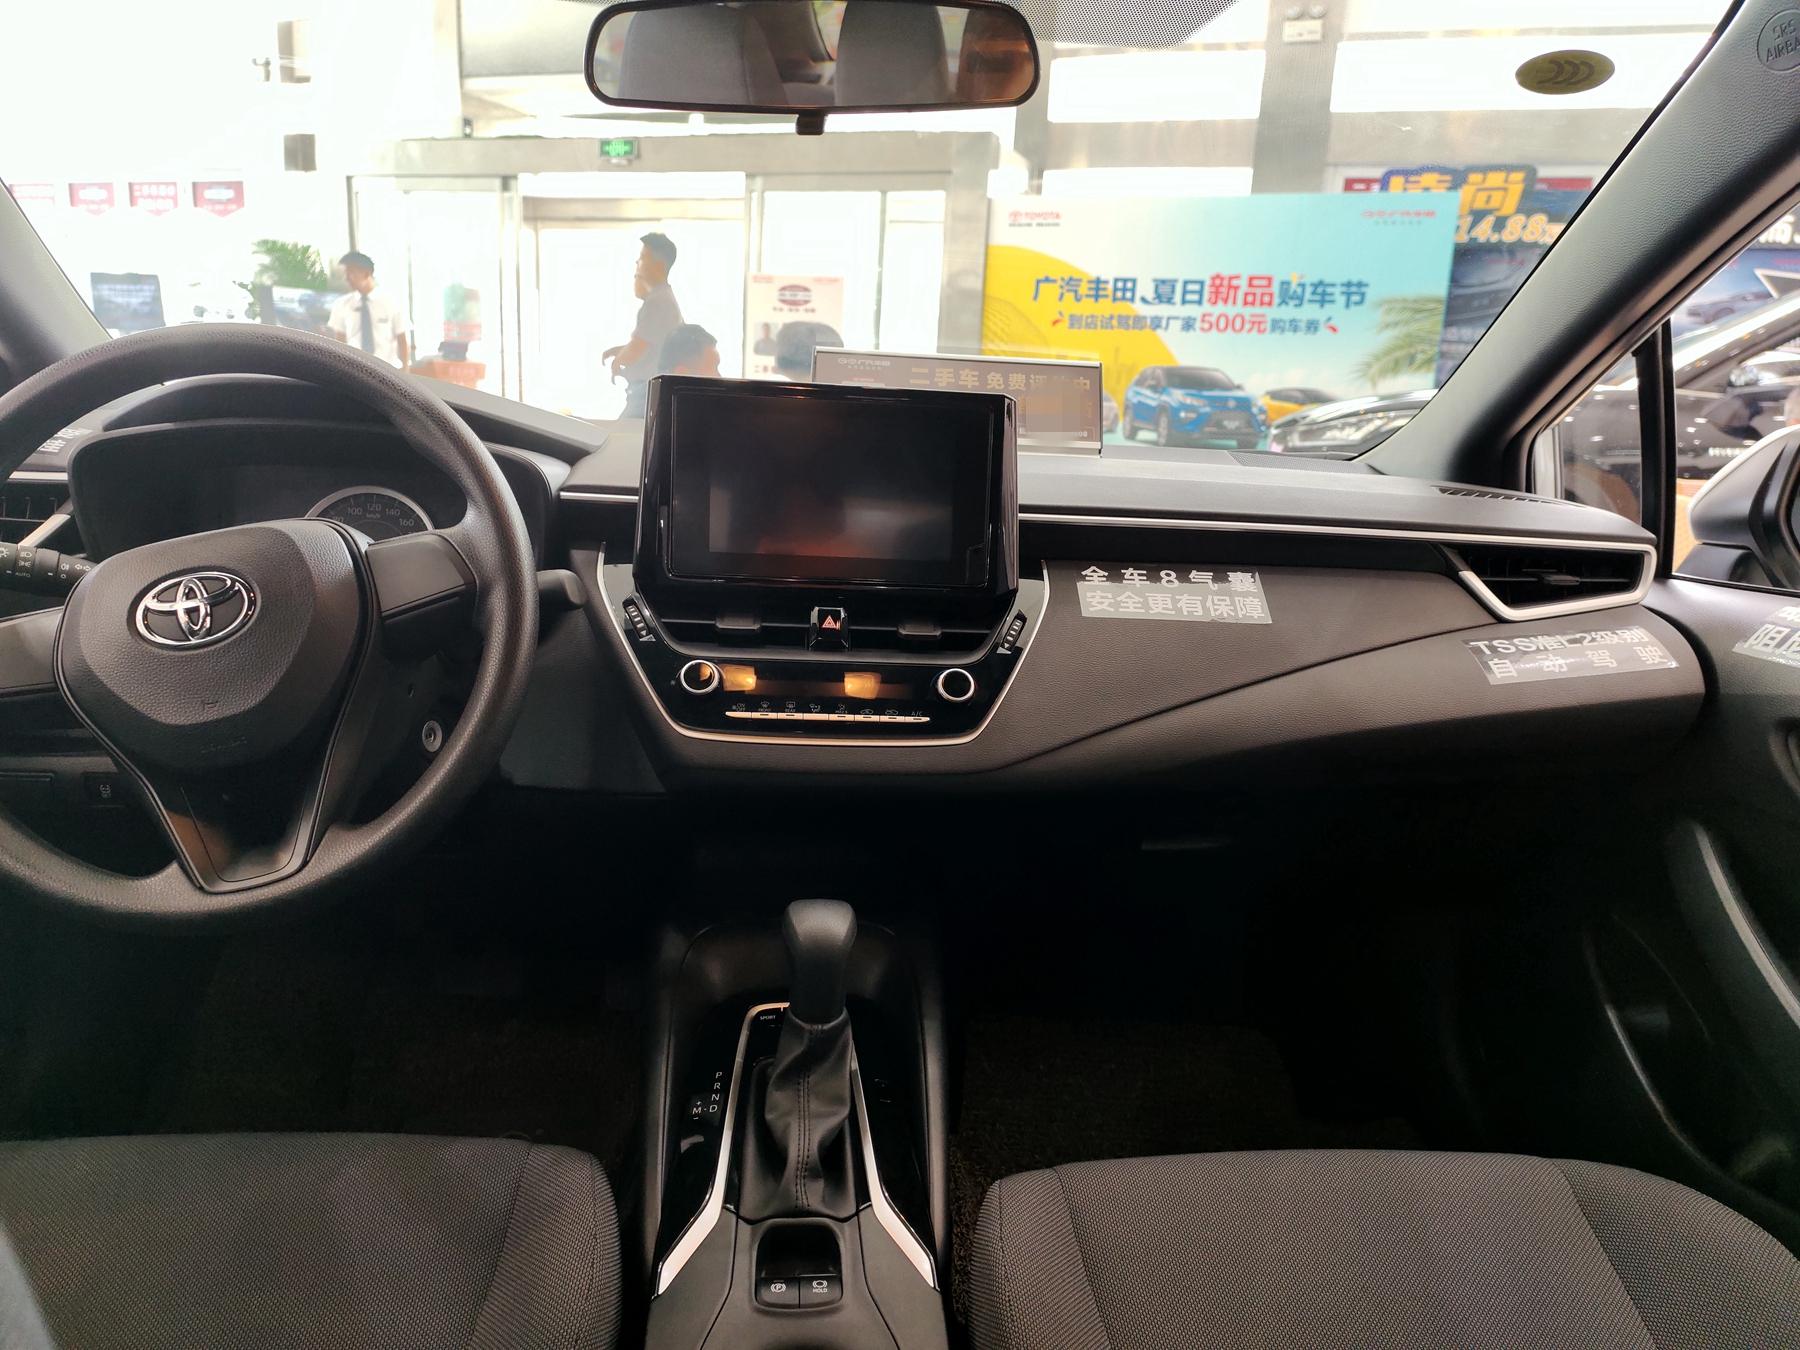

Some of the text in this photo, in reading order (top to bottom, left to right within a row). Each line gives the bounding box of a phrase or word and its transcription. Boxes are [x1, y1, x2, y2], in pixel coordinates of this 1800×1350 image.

[1773, 19, 1796, 41] SRS
[909, 367, 980, 389] 二手车
[347, 507, 400, 516] 100 140
[366, 503, 381, 511] 120
[400, 518, 415, 526] 160
[1081, 565, 1258, 593] 全车8气囊
[1086, 591, 1265, 619] 安全更有保障
[1469, 628, 1650, 655] TSS准L2级别
[1488, 645, 1669, 678] 自动驾驶
[715, 1071, 723, 1079] P
[713, 1082, 721, 1090] R
[711, 1093, 720, 1101] N
[692, 1106, 702, 1115] M
[709, 1104, 718, 1113] D
